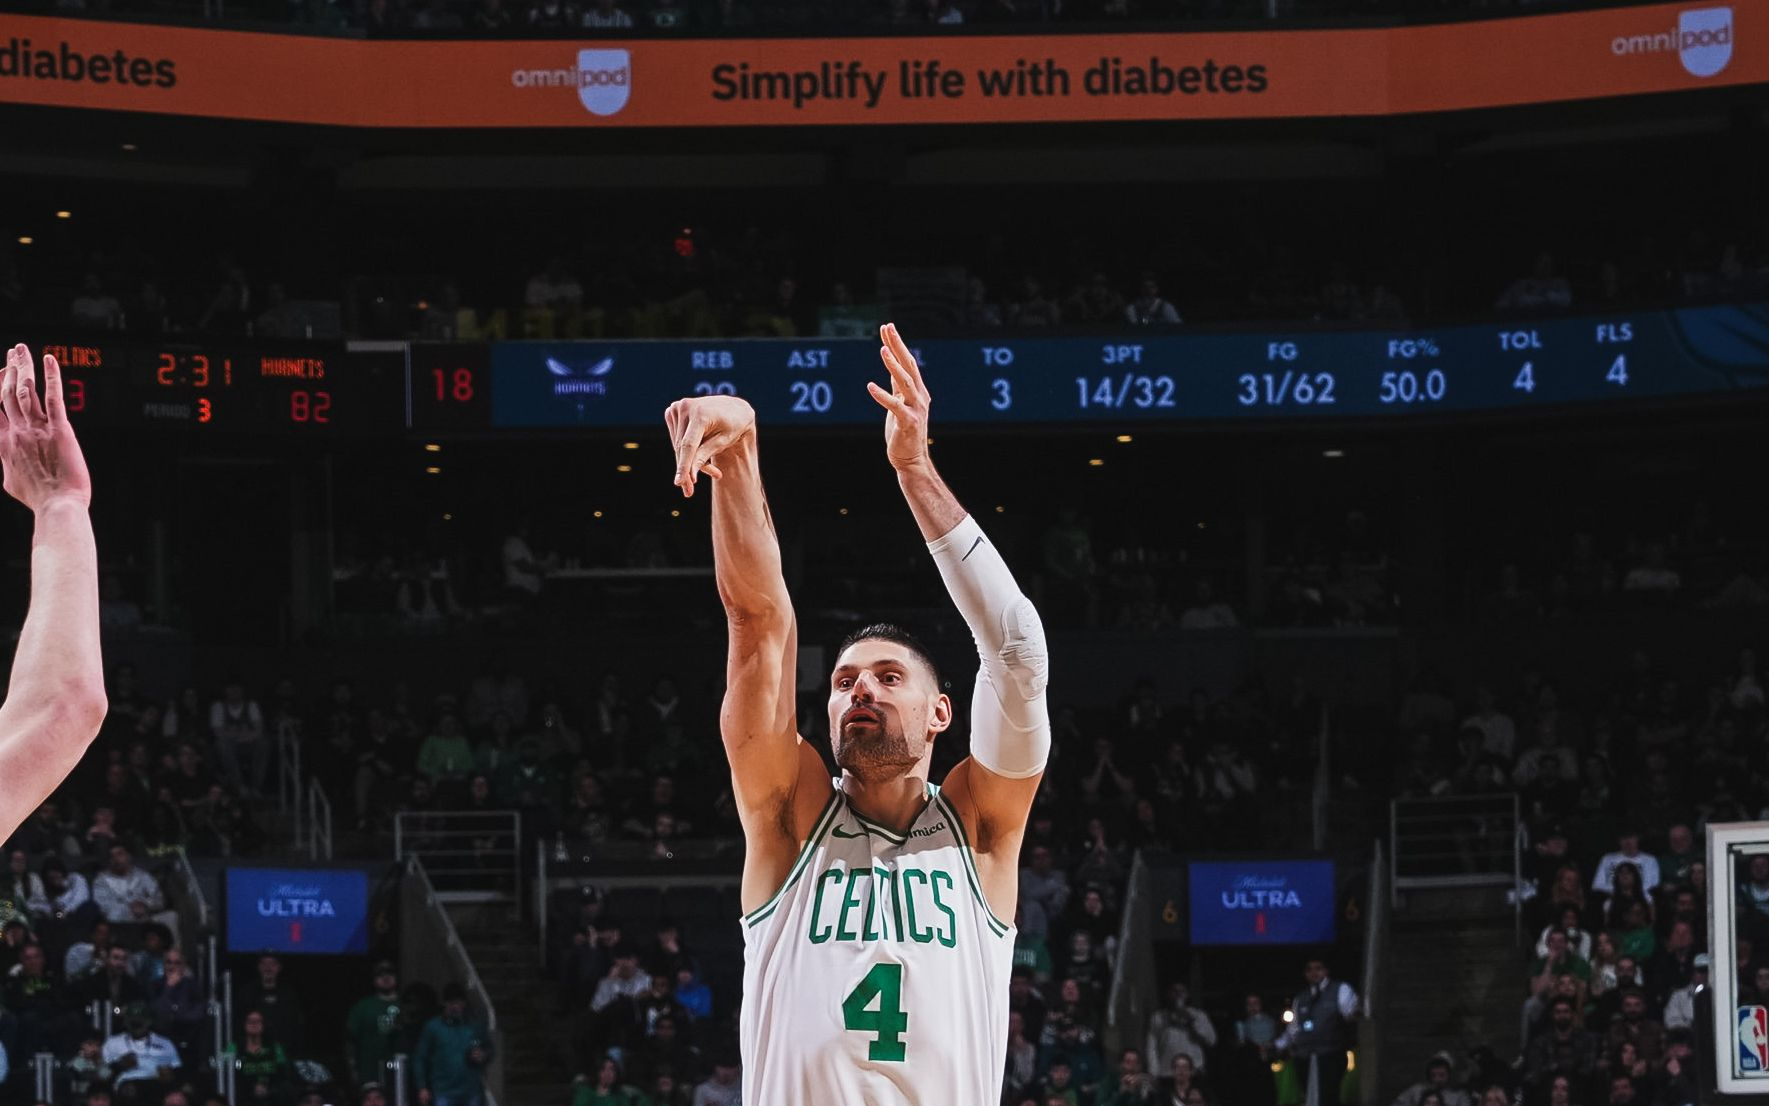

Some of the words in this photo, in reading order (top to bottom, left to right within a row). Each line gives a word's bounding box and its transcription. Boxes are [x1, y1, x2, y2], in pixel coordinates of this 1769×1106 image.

[1611, 25, 1729, 56] omnipod
[0, 38, 176, 88] diabetes
[511, 66, 627, 88] omnipod
[711, 61, 886, 109] Simplify
[900, 60, 965, 98] life
[976, 59, 1070, 97] with
[1083, 57, 1268, 96] diabetes
[1388, 337, 1440, 358] FG%
[1499, 331, 1543, 350] TOL
[1596, 323, 1634, 343] FLS
[691, 350, 734, 369] REB
[787, 350, 831, 368] AST
[982, 347, 1014, 366] TO
[1102, 345, 1143, 363] 3PT
[1267, 341, 1299, 360] FG
[433, 368, 475, 401] 18
[1380, 368, 1446, 402] 50.0
[1513, 361, 1536, 393] 4
[1605, 353, 1629, 386] 4
[788, 381, 833, 412] 20
[990, 378, 1012, 410] 3
[1075, 373, 1177, 408] 14/32
[1237, 370, 1336, 406] 31/62
[197, 397, 213, 423] 3
[290, 391, 332, 423] 82
[909, 821, 945, 838] mica
[256, 898, 335, 917] ULTRA
[808, 867, 957, 949] CELTICS
[1221, 889, 1301, 909] ULTRA
[842, 962, 908, 1062] 4
